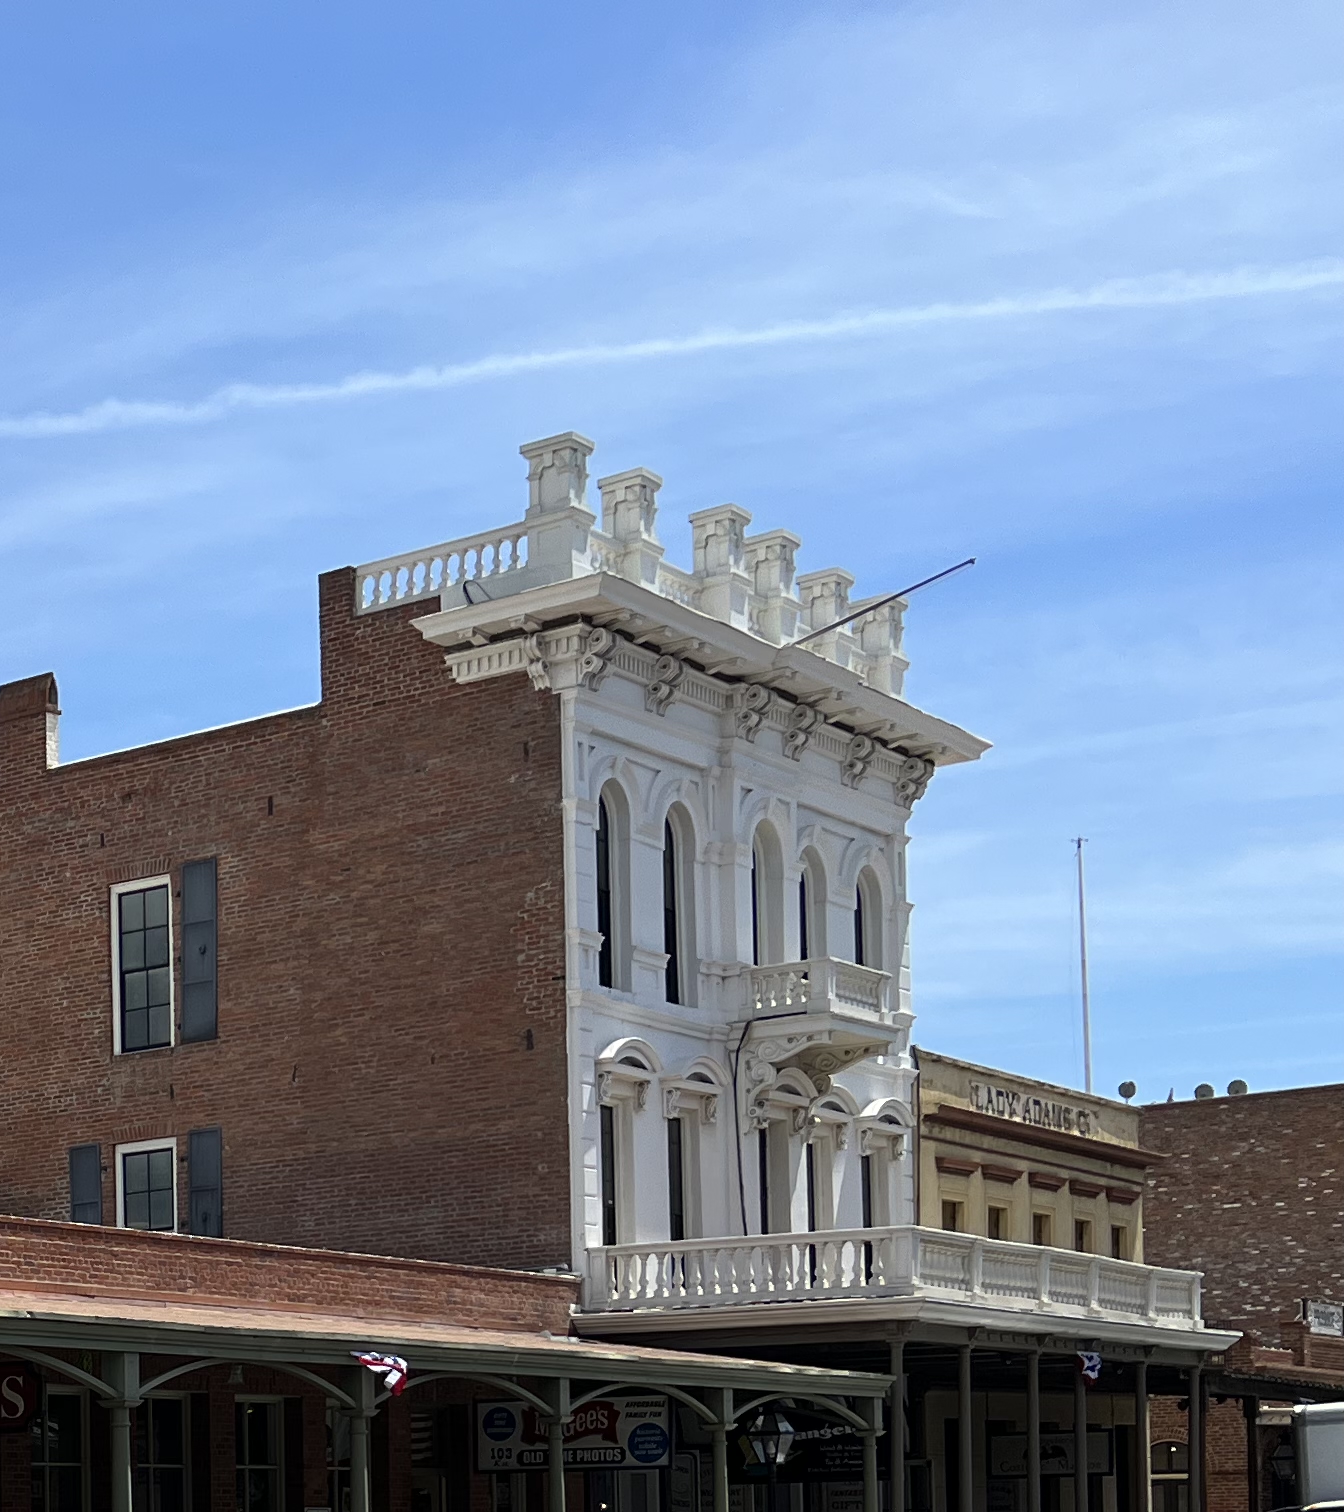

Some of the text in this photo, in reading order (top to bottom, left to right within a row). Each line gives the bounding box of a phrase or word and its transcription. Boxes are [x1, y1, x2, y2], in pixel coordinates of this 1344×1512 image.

[970, 1083, 1020, 1119] LADY
[624, 1400, 666, 1409] AFFORDABLE
[533, 1405, 609, 1438] MGee's
[491, 1448, 512, 1461] 103
[523, 1451, 544, 1464] OLD
[576, 1446, 622, 1463] PHOTOS
